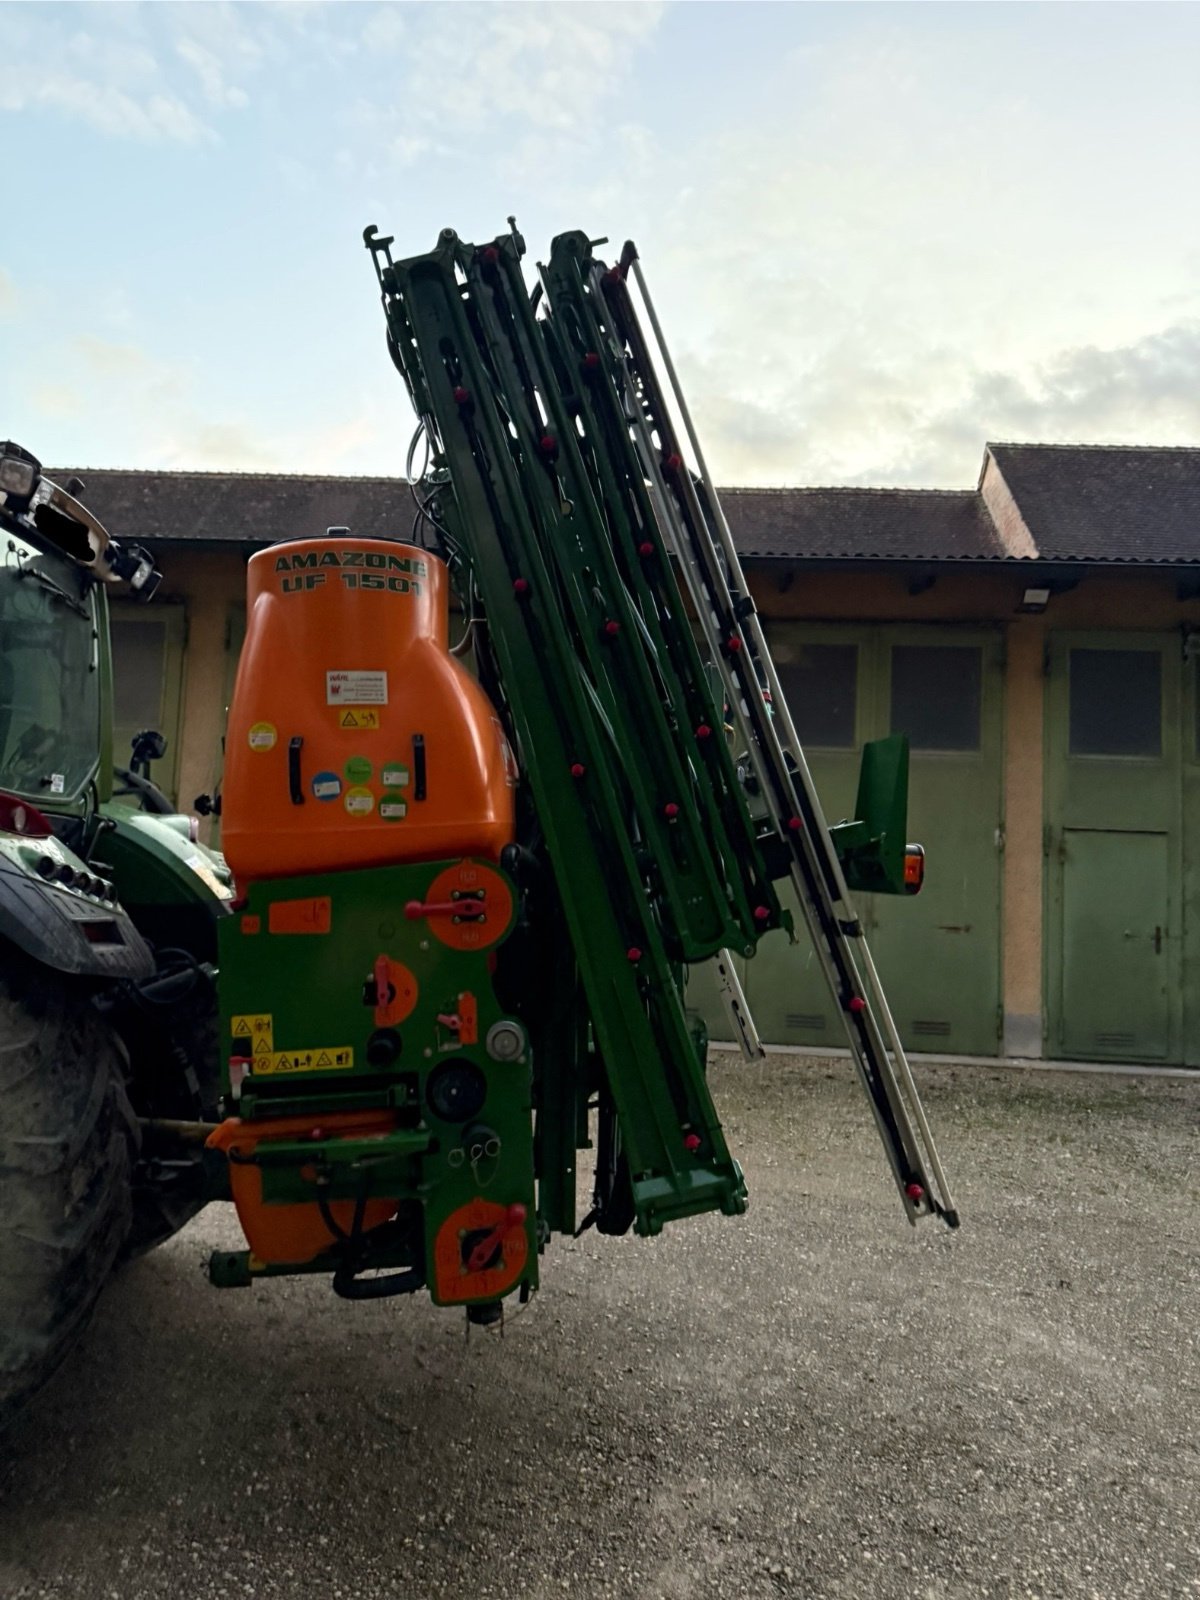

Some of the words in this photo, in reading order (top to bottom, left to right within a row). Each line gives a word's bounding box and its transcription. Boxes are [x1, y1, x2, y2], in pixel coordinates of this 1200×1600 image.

[275, 551, 427, 577] AMAZONE
[282, 573, 327, 593] UF
[341, 572, 422, 597] 1501
